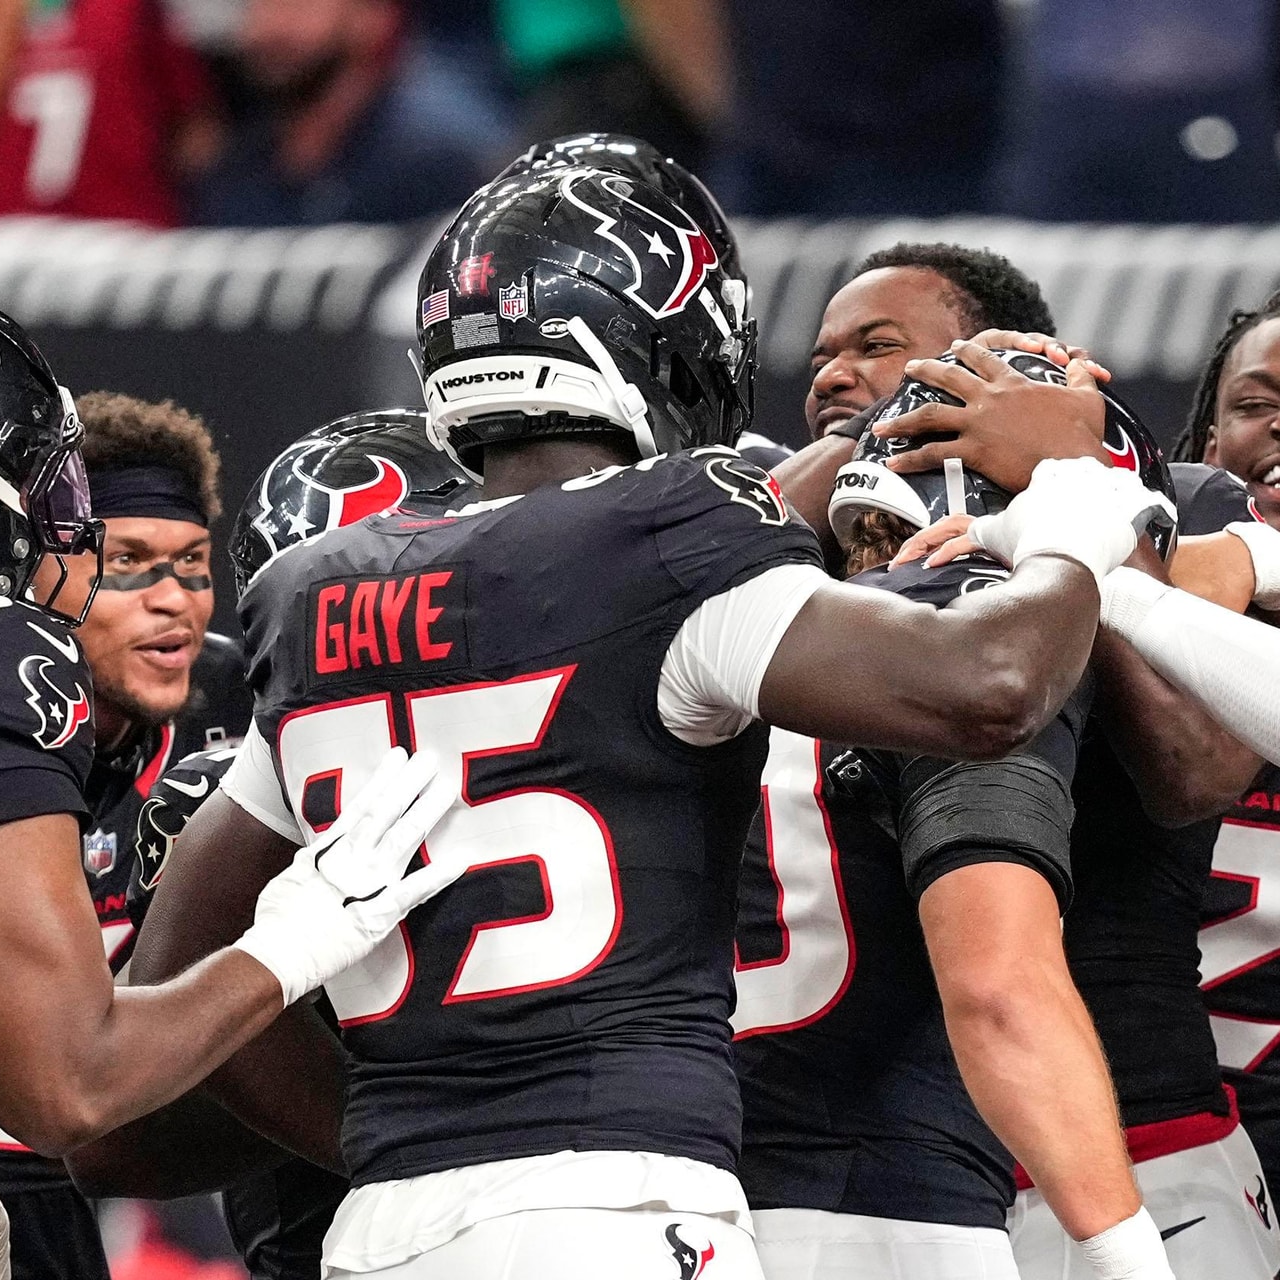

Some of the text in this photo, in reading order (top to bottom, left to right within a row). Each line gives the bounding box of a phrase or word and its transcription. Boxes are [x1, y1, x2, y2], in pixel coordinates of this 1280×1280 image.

[503, 300, 524, 316] NFL
[442, 371, 524, 389] HOUSTON
[835, 472, 880, 490] TON
[314, 571, 454, 674] GAYE
